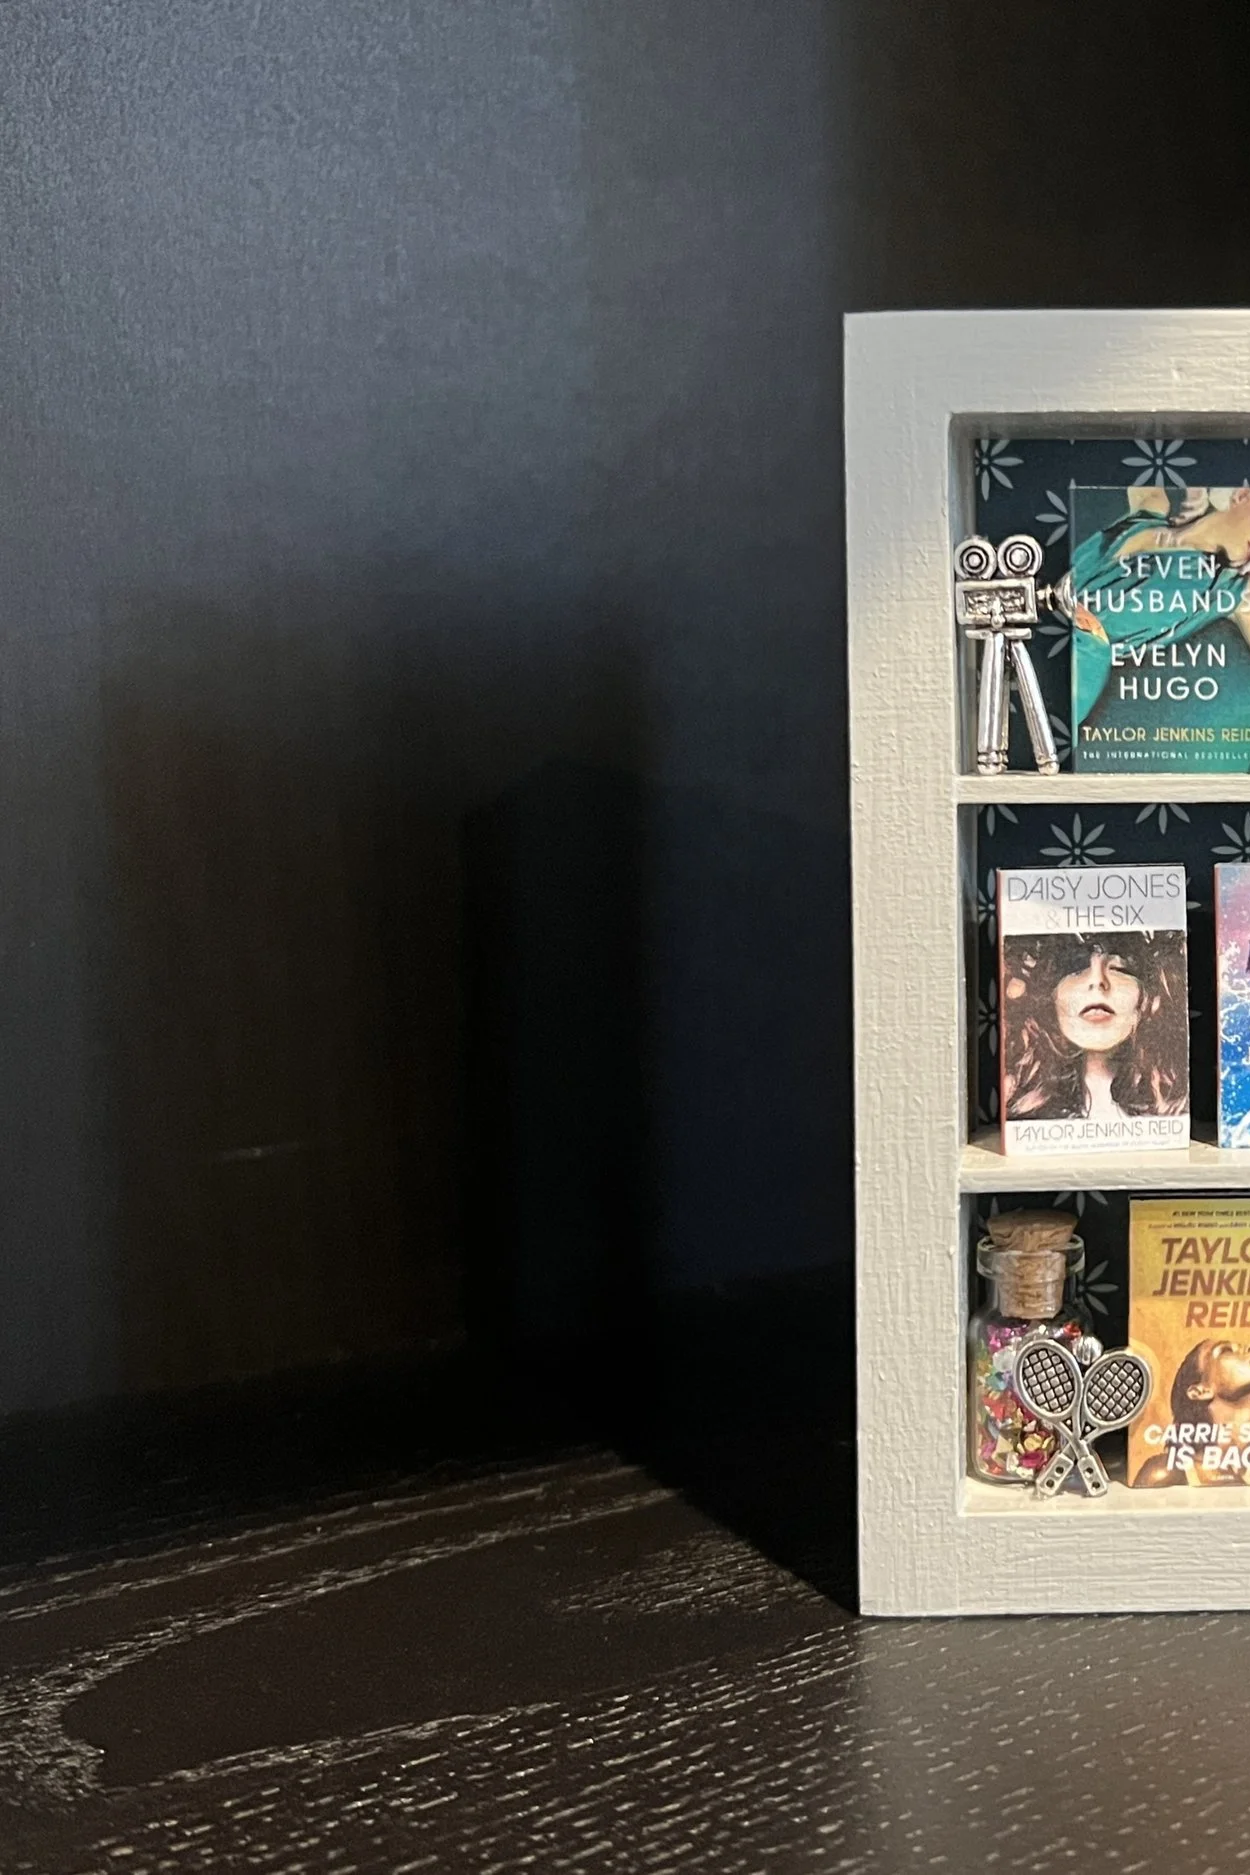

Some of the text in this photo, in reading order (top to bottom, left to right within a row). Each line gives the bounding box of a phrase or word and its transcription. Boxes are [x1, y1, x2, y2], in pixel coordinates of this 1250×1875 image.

[1119, 554, 1216, 580] SEVEN
[1111, 643, 1226, 667] EVELYN
[1120, 676, 1218, 700] HUGO
[1082, 726, 1146, 742] TAYLOR
[1153, 727, 1215, 743] JENKINS
[1007, 873, 1181, 901] DAISY JONES
[1062, 905, 1105, 928] THE
[1111, 904, 1144, 927] SIX
[1013, 1119, 1184, 1143] TAYLOR JENKINS REID
[1144, 1423, 1234, 1445] CARRIE
[1167, 1446, 1196, 1471] IS
